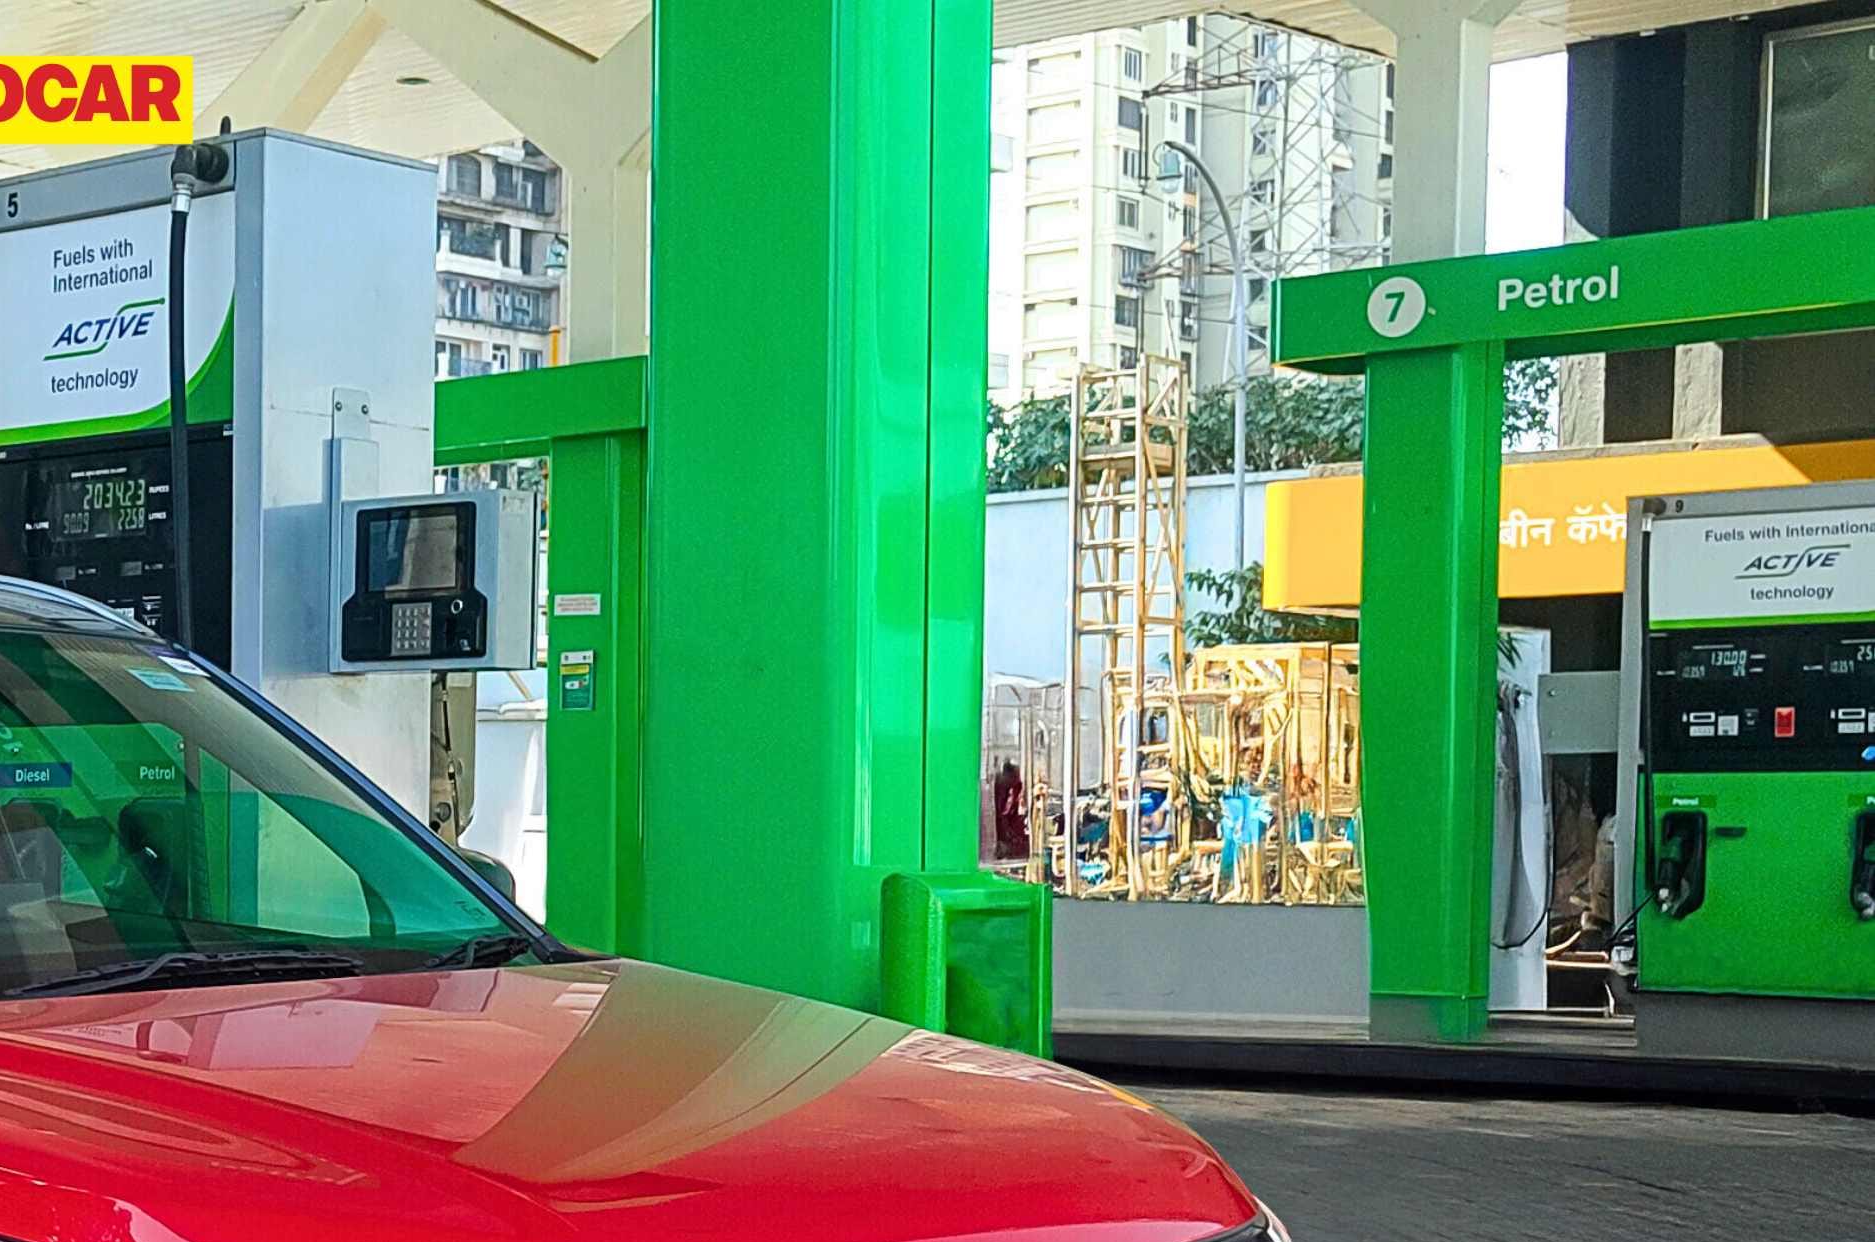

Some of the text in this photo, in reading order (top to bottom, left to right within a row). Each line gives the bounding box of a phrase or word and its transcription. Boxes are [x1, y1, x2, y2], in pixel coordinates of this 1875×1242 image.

[7, 192, 19, 218] 5
[53, 238, 134, 269] Fuels with
[53, 259, 153, 293] International
[1384, 265, 1619, 323] 7 Petrol
[48, 306, 160, 353] ACTIVE
[51, 368, 139, 393] technology
[1674, 499, 1685, 514] 9
[1704, 520, 1875, 543] Fuels with Internationa
[1739, 547, 1846, 575] ACTIVE
[1750, 585, 1835, 601] technology
[14, 767, 51, 783] Diesel
[139, 765, 176, 781] Petrol
